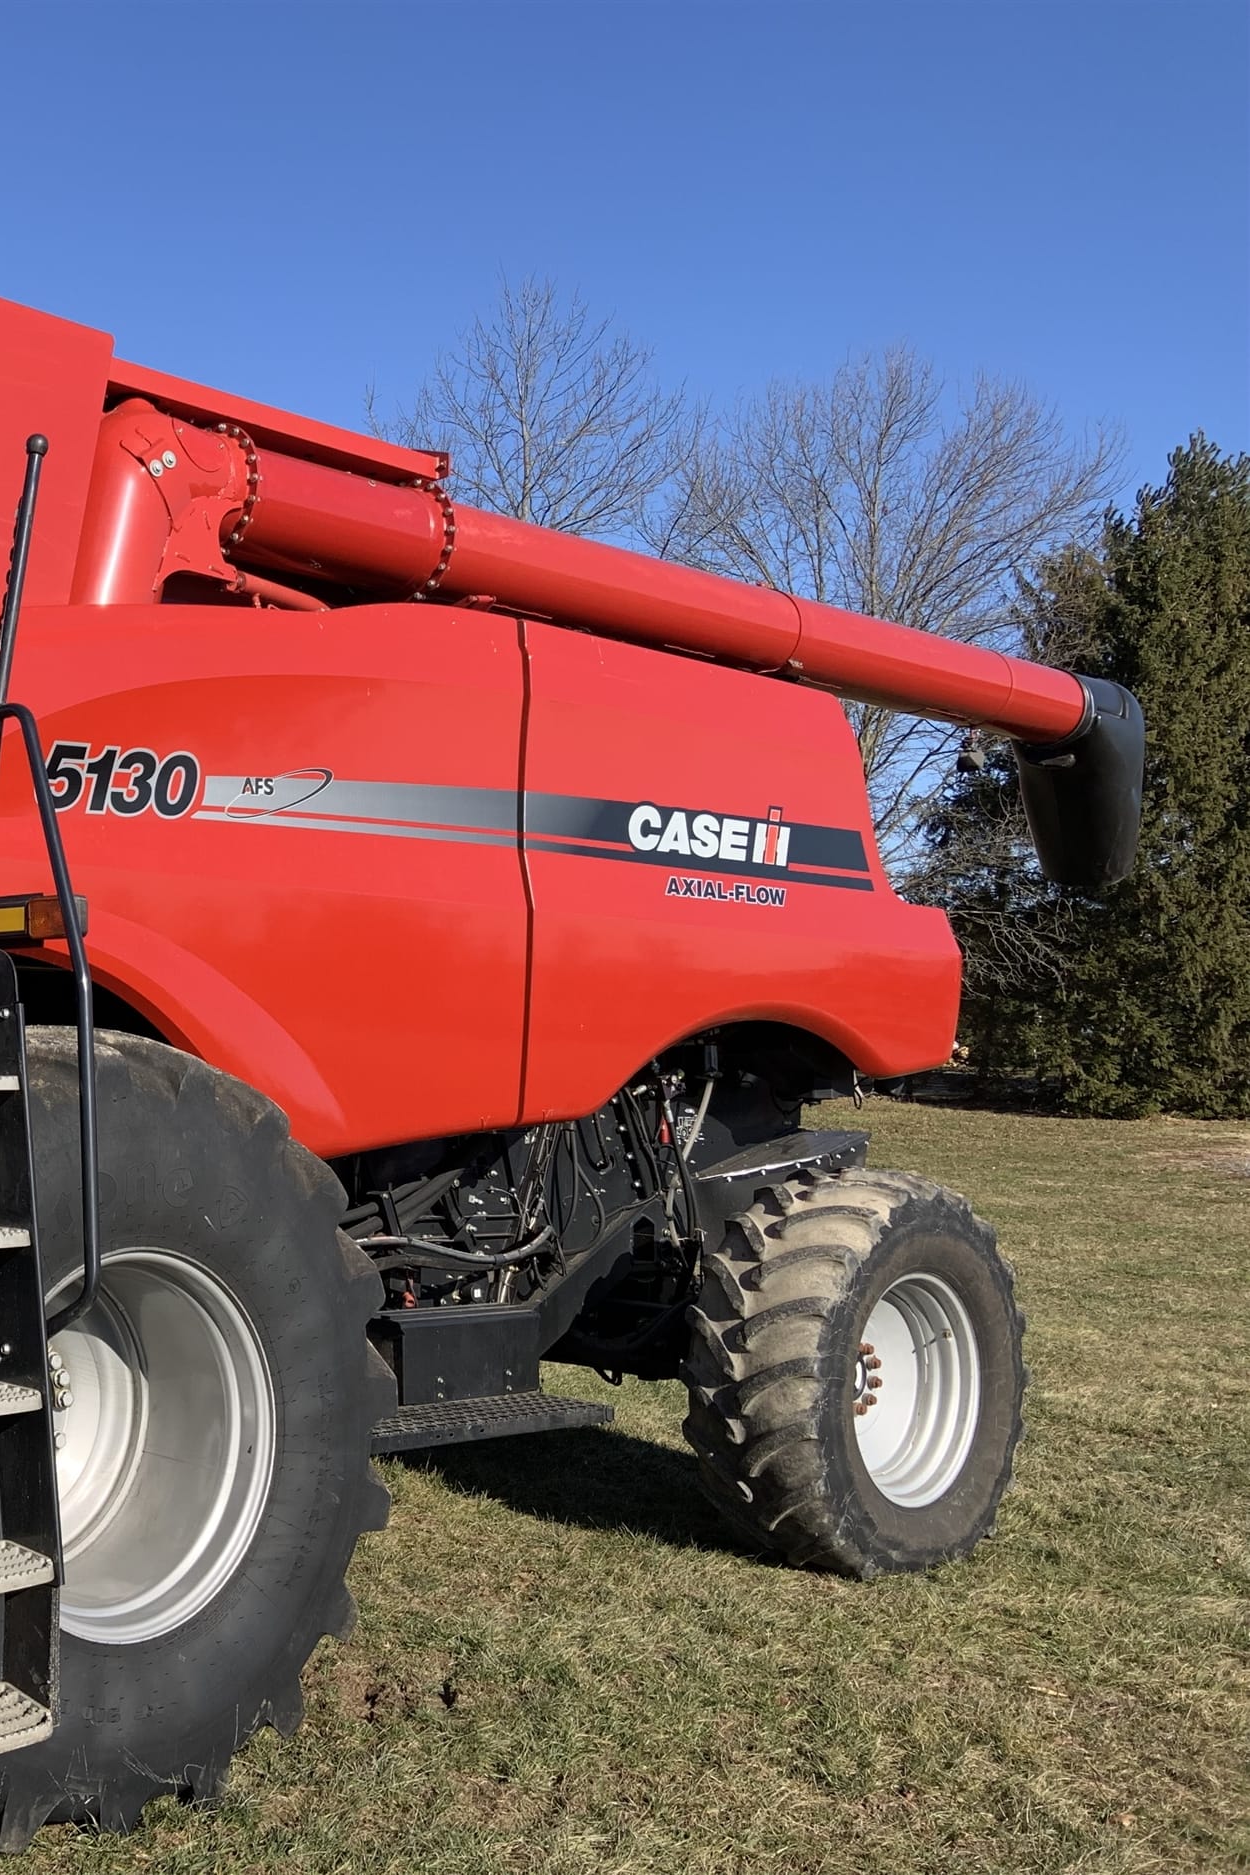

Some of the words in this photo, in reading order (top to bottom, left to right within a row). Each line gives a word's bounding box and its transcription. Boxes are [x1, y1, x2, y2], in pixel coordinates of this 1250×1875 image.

[38, 740, 201, 820] 5130
[241, 776, 274, 796] AFS
[665, 876, 786, 907] AXIAL-FLOW
